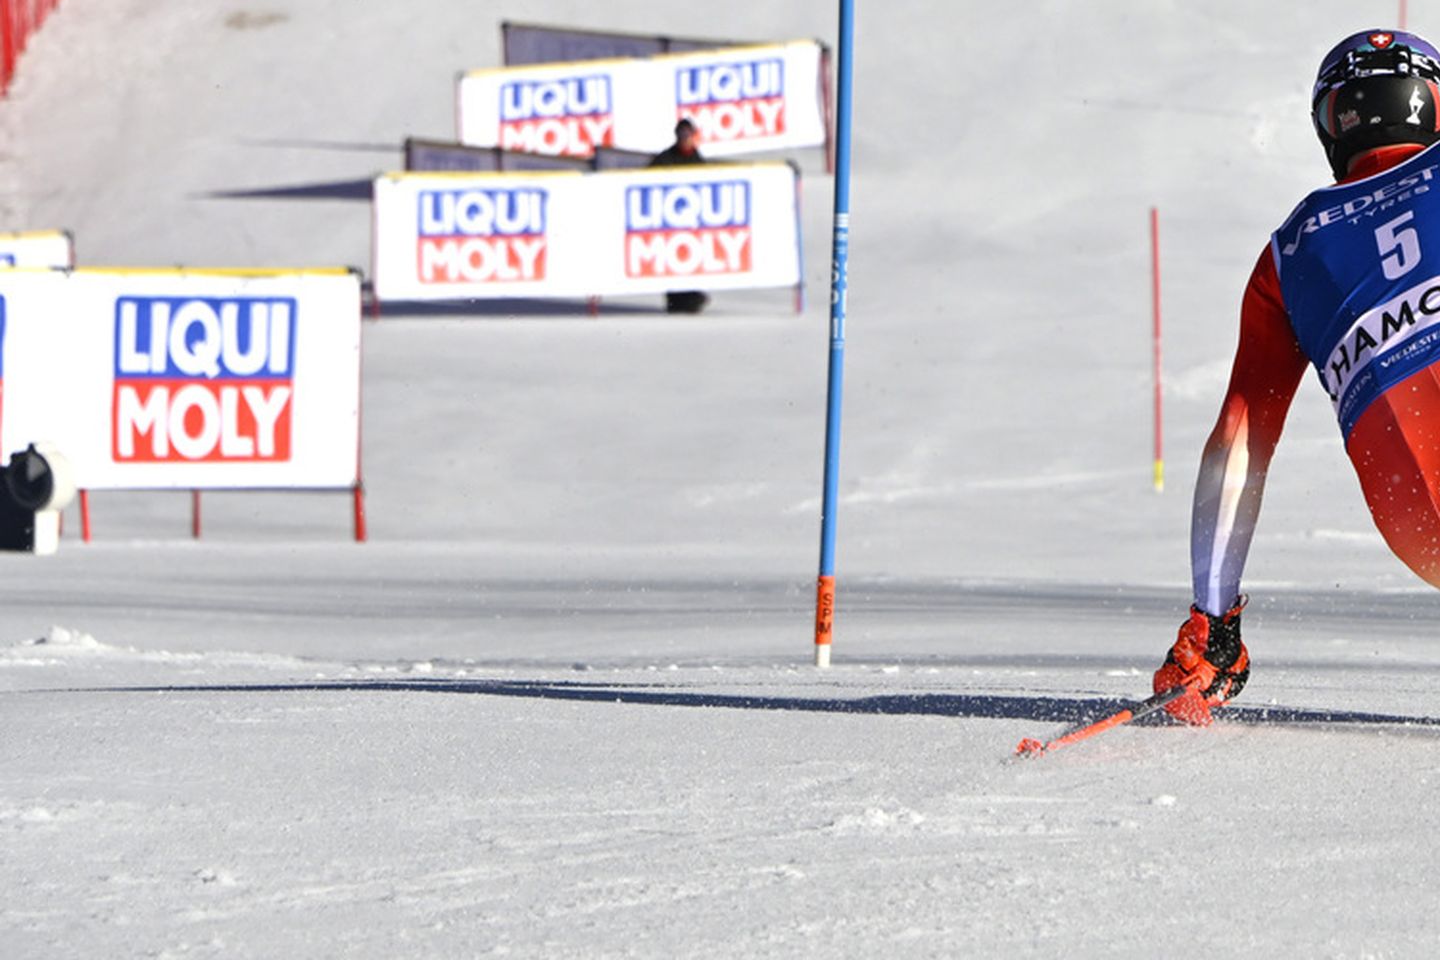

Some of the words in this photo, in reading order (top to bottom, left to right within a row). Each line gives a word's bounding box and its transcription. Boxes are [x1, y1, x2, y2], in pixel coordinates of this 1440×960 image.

[501, 76, 610, 120] LIQUI
[678, 59, 784, 103] LIQUI
[501, 115, 612, 157] MOLY
[679, 101, 785, 141] MOLY
[423, 191, 545, 235] LIQUI
[629, 183, 748, 230] LIQUI
[1348, 184, 1430, 225] TYRES
[422, 238, 546, 281] MOLY
[629, 228, 750, 275] MOLY
[1374, 210, 1422, 281] 5
[119, 300, 290, 378] LIQUI
[117, 384, 292, 459] MOLY
